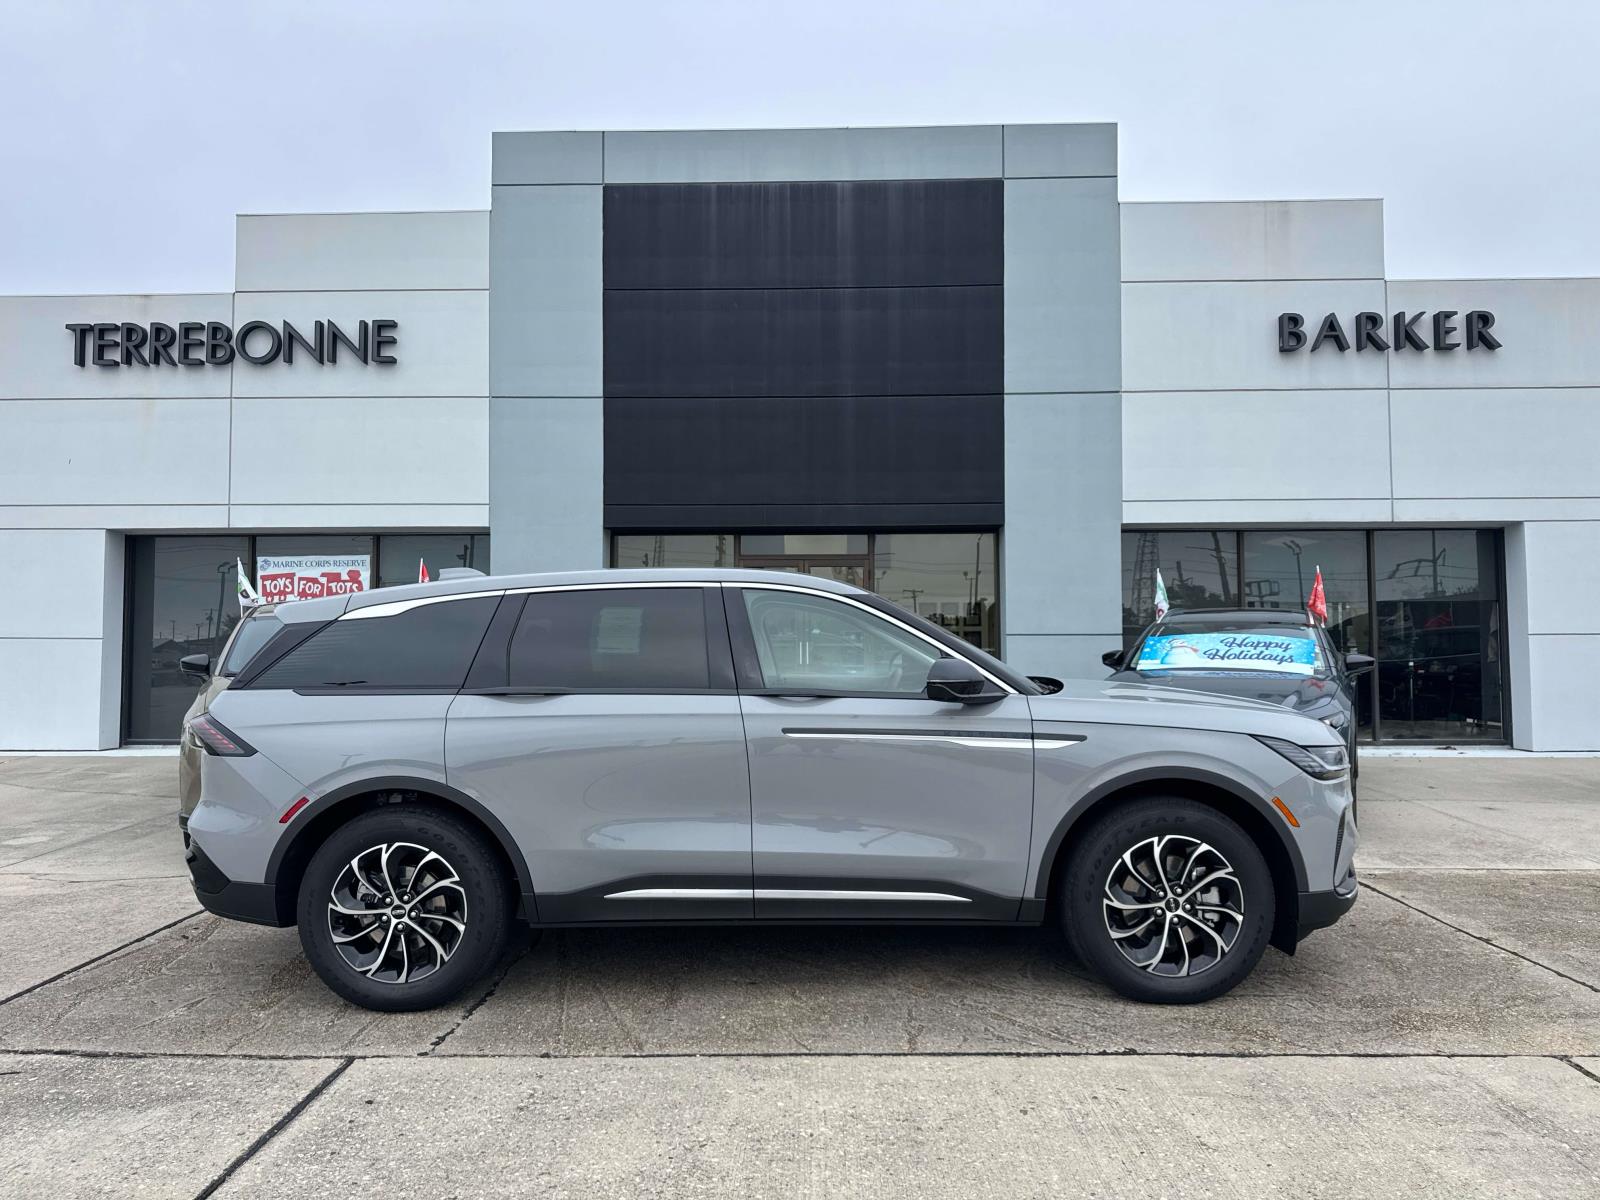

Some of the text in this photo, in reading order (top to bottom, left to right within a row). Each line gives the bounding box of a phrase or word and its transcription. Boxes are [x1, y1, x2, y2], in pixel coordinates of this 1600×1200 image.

[1278, 310, 1503, 353] BARKER
[66, 319, 398, 367] TERREBONNE
[272, 560, 303, 568] MARINE
[333, 559, 366, 567] RESERVE
[263, 577, 358, 596] TOYS FOR TOTS
[1220, 637, 1292, 652] Happy
[1203, 648, 1294, 665] Holidays
